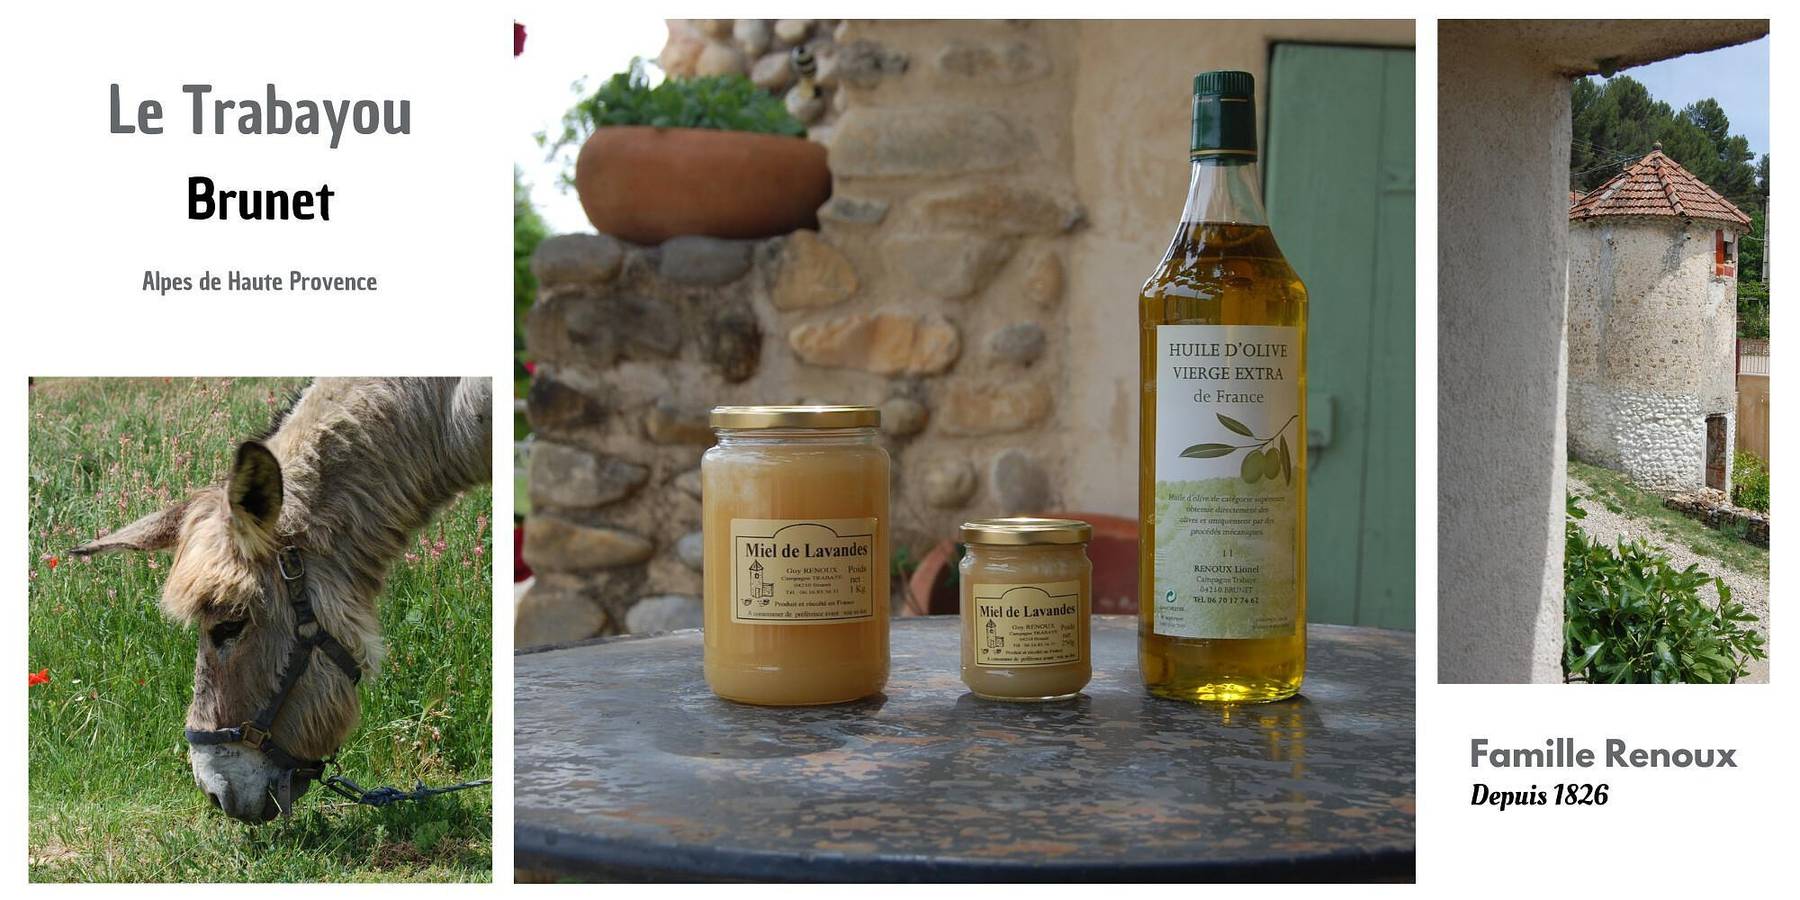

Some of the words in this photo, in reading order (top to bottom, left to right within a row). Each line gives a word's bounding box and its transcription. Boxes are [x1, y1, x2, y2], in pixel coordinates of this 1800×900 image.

[1170, 344, 1219, 357] HUILE
[1225, 342, 1288, 357] D'OLIVE
[1173, 367, 1230, 380] VIERGE
[1235, 368, 1283, 380] EXTRA
[1194, 389, 1211, 403] de
[1217, 390, 1264, 403] France
[746, 543, 777, 558] Miel
[782, 544, 799, 558] de
[805, 542, 868, 558] Lavandes
[1194, 565, 1232, 573] RENOUX
[1235, 565, 1259, 573] Lionel
[980, 606, 1003, 618] Miel
[1006, 606, 1020, 618] de
[1024, 604, 1076, 618] Lavandes
